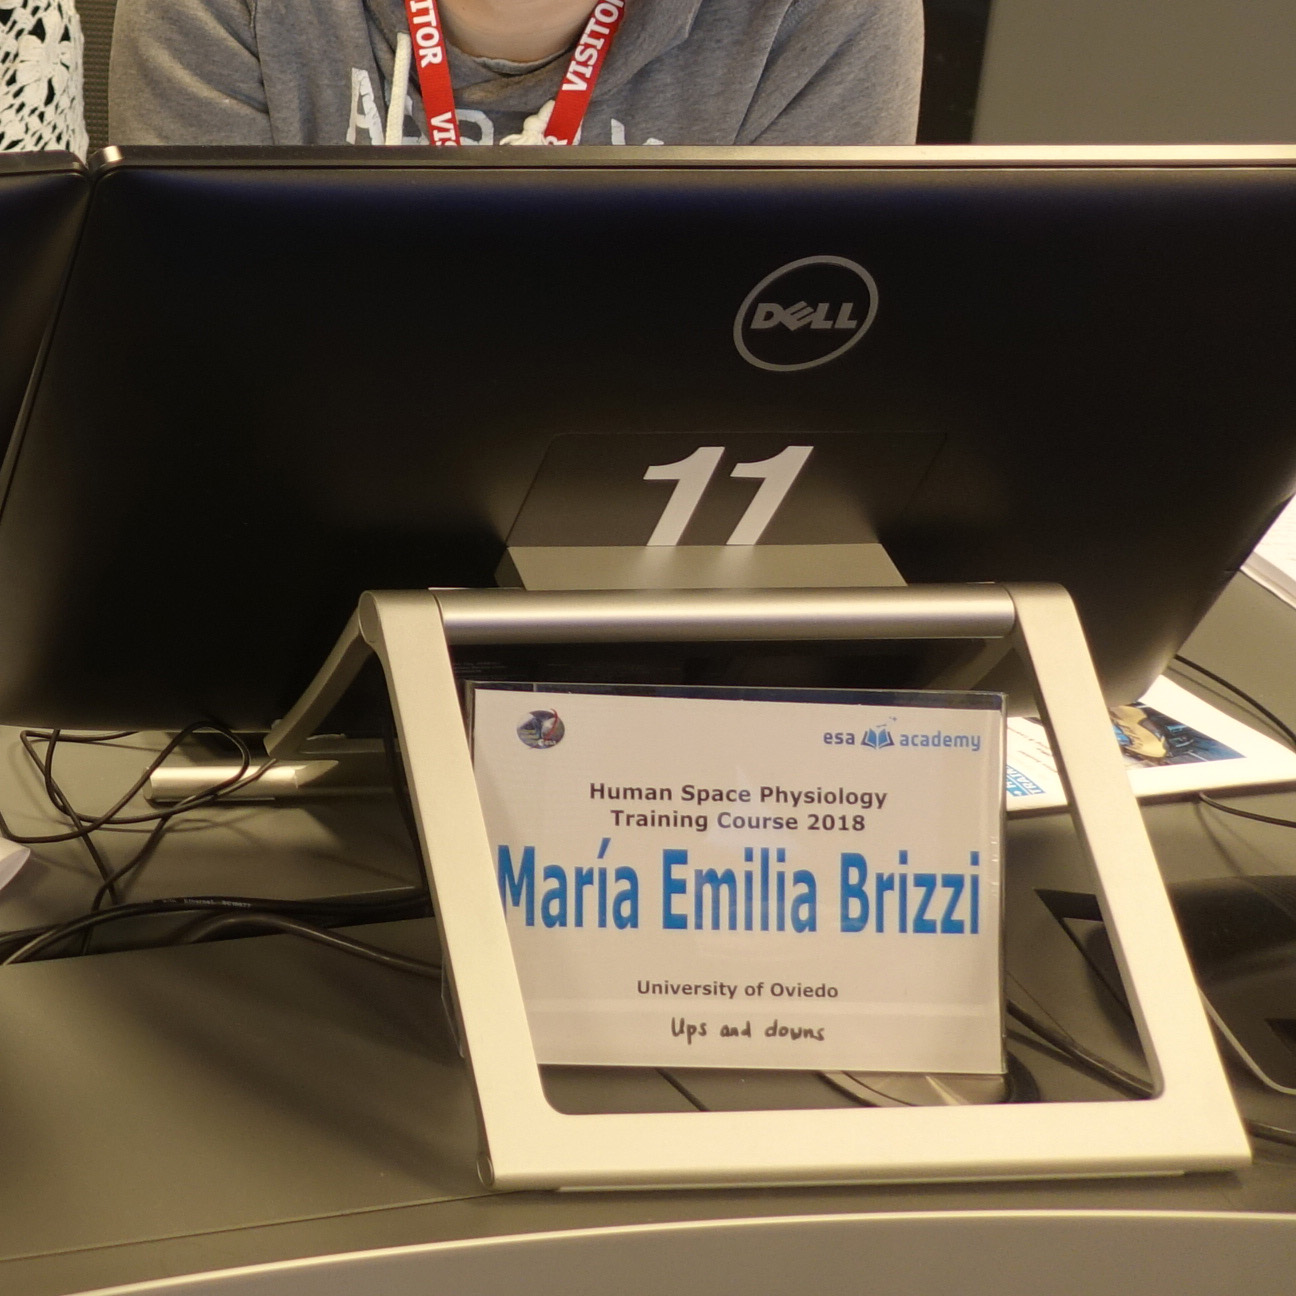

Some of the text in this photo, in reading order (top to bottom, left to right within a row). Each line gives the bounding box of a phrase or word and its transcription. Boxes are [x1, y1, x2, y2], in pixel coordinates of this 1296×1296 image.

[751, 301, 858, 331] DELL
[643, 445, 814, 546] 11
[823, 730, 982, 751] esa academy
[589, 783, 888, 809] Human Space Physiology
[610, 809, 866, 832] Training Course 2018
[497, 837, 980, 935] María Emilia Brizzi
[637, 980, 839, 999] University of Oviedo
[670, 1017, 826, 1045] Ups and downs
